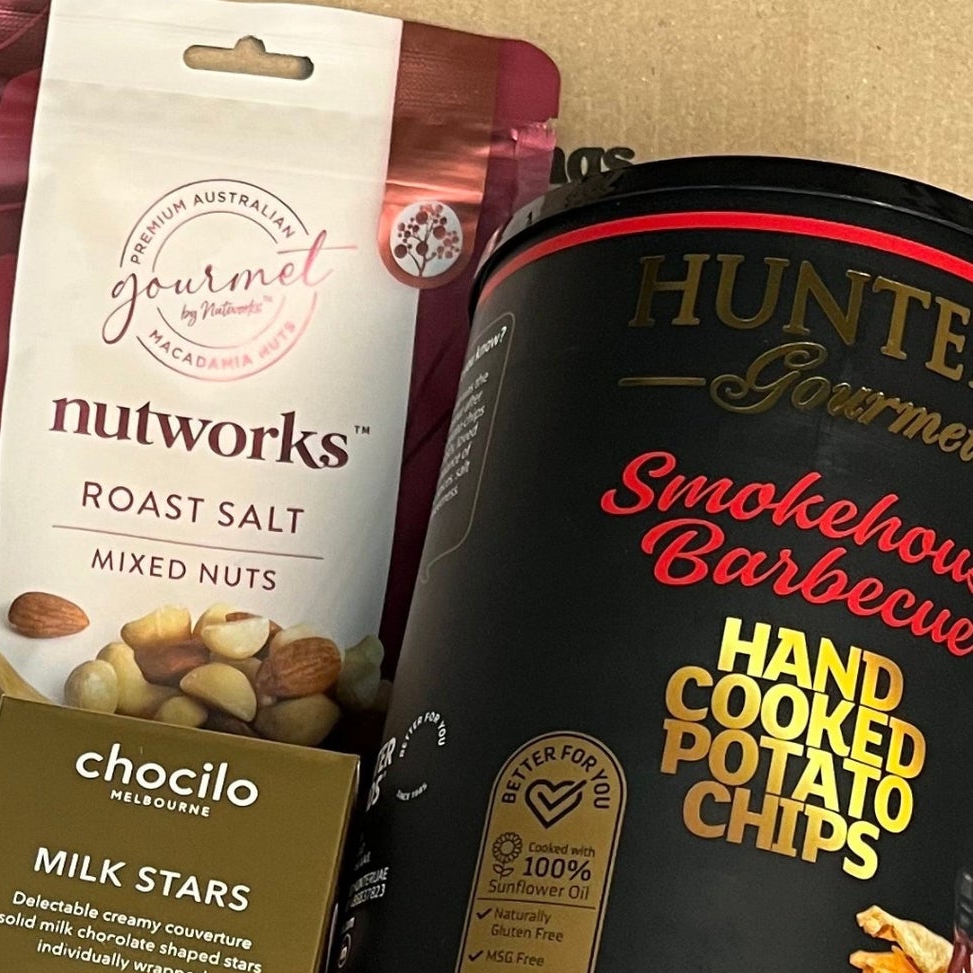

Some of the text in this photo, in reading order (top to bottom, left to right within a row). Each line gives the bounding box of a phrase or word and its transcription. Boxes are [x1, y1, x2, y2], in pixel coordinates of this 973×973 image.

[130, 191, 295, 265] PREMIUM AUSTRALIAN
[102, 229, 358, 344] gourmet
[148, 320, 296, 370] MACADAMIA NUTS
[628, 252, 973, 388] HUNTE
[49, 397, 349, 470] nutworks
[82, 480, 305, 534] ROAST SALT
[600, 451, 973, 595] Smokehou
[90, 548, 277, 591] MIXED NUTS
[641, 518, 973, 656] Barbecue
[717, 616, 904, 712] HAND
[665, 665, 926, 779] COOKED
[75, 743, 259, 807] chocilo
[110, 789, 211, 818] MELBOURNE
[501, 744, 611, 809] BETTER FOR YOU
[660, 717, 914, 833] POTATO
[528, 842, 596, 858] Cooked with
[683, 780, 881, 880] CHIPS
[33, 846, 251, 912] MILK STARS
[488, 879, 589, 900] Sunflower Oil
[522, 856, 592, 882] 100%
[12, 890, 253, 950] Delectable creamy couverture
[39, 919, 73, 937] milk
[77, 924, 155, 953] chocolate
[159, 941, 220, 966] shaped
[490, 923, 564, 943] Gluten Free
[494, 907, 552, 925] Naturally
[37, 939, 130, 971] individually
[485, 950, 545, 967] MSG Free
